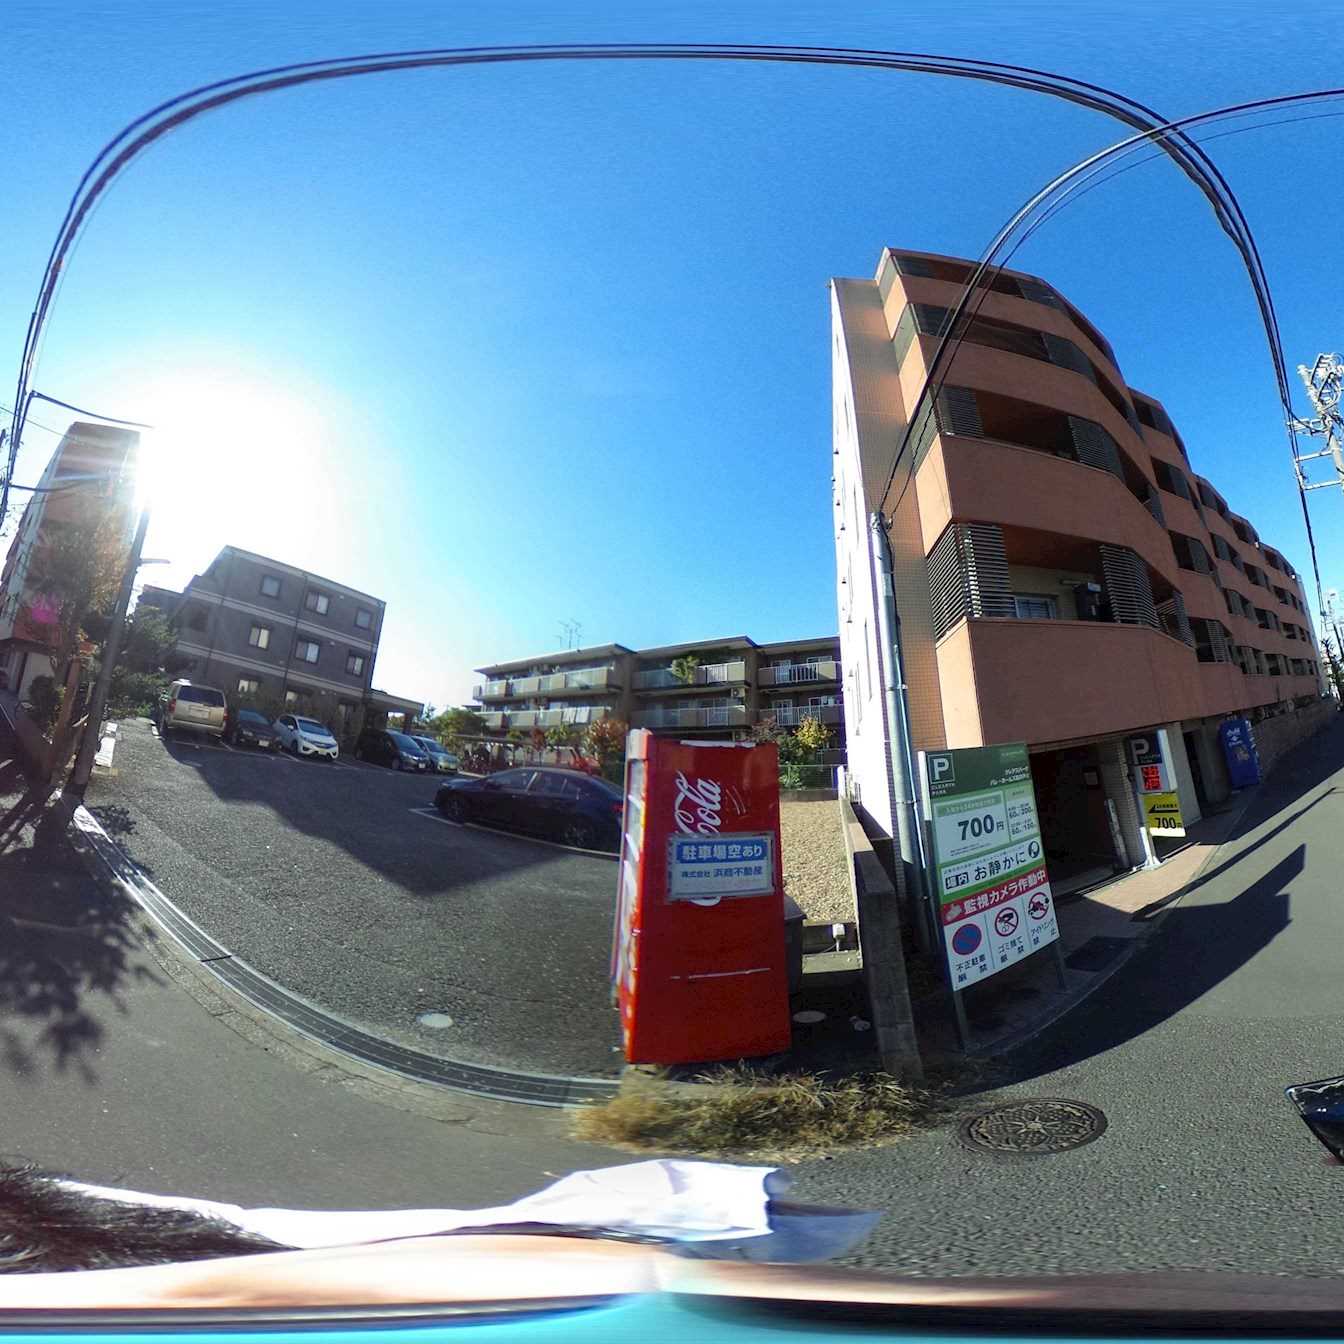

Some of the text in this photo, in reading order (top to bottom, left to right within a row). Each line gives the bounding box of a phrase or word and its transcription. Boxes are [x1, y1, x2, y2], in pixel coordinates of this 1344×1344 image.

[933, 758, 950, 781] P
[682, 844, 763, 861] 駐車場空あり
[963, 870, 1047, 914] 監視カメラ作動中
